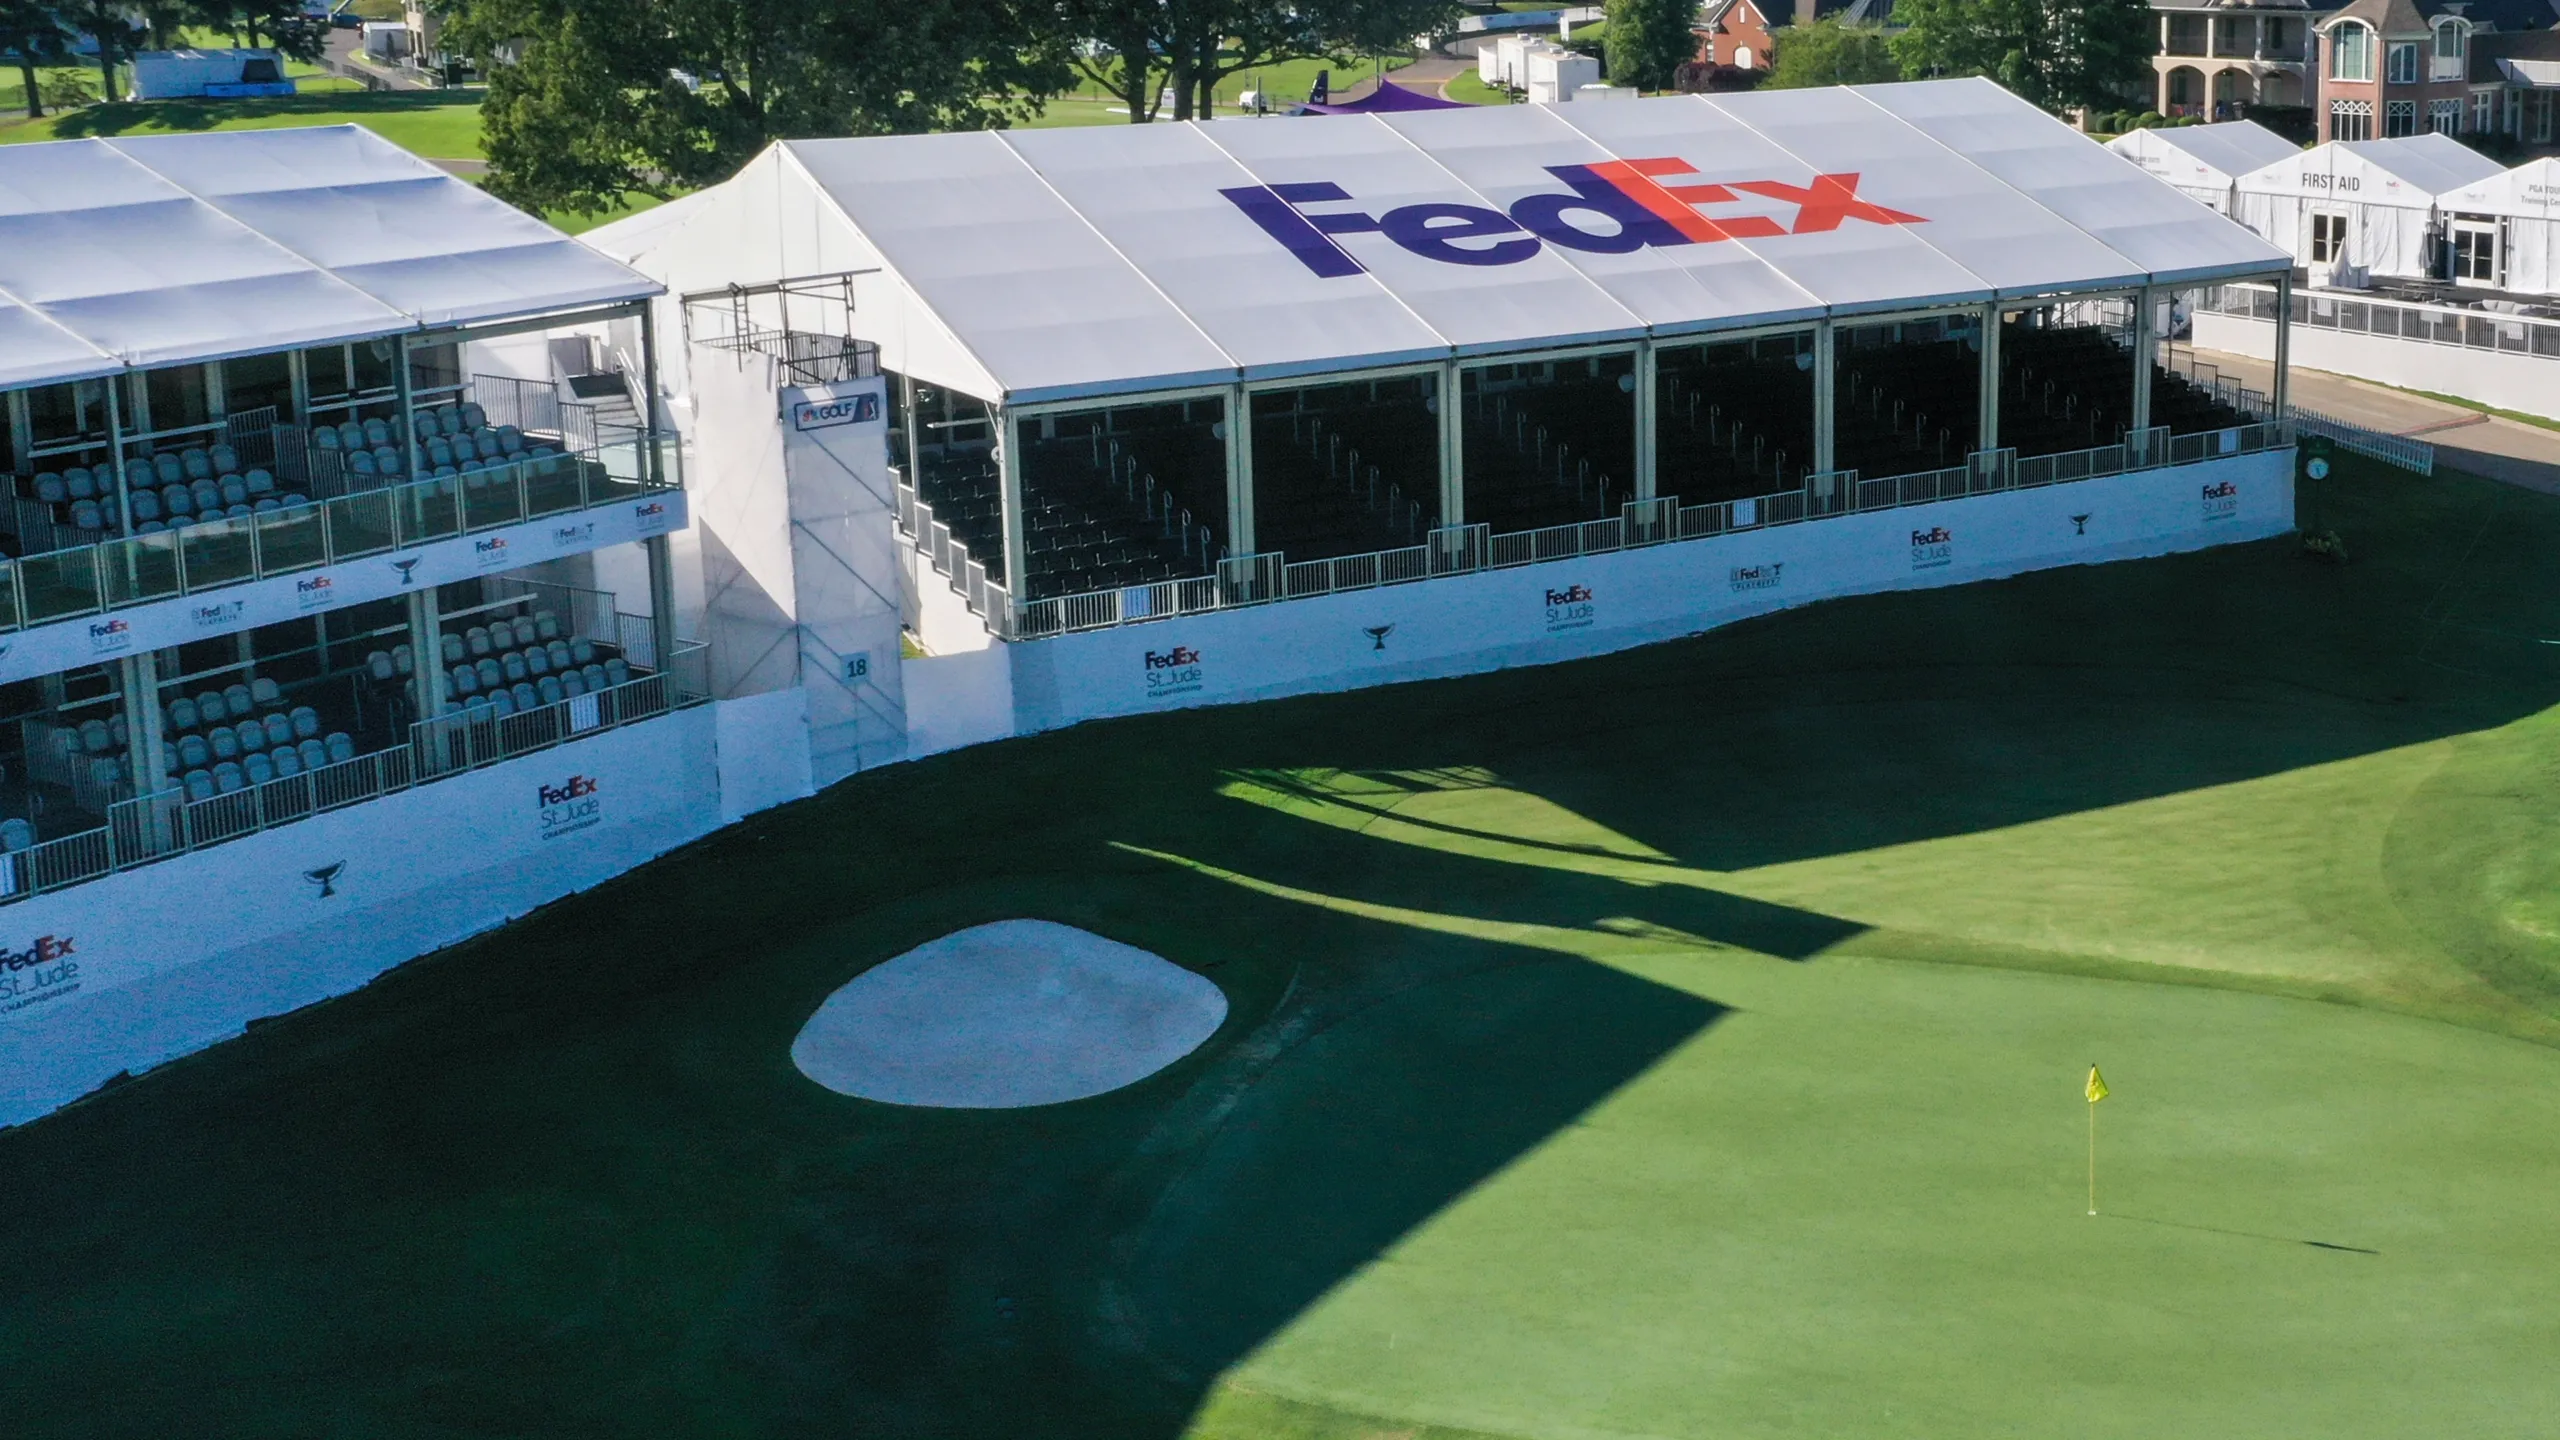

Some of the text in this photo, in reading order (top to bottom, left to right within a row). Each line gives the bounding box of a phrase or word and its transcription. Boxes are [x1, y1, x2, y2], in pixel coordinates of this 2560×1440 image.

[2302, 172, 2360, 191] FIRST AID
[2545, 185, 2560, 194] TOU
[1217, 156, 1933, 279] FedEx
[820, 403, 852, 419] GOLF
[2202, 481, 2237, 500] FedEx
[636, 503, 664, 517] FedEx
[476, 537, 507, 553] FedEx
[1912, 527, 1951, 546] FedEx
[297, 576, 332, 592] FedEx
[1545, 584, 1592, 606] FedEx
[1564, 603, 1594, 620] Jude
[90, 620, 129, 637] FedEx
[847, 658, 867, 678] 18
[1145, 647, 1200, 670] FedEx
[1166, 666, 1202, 686] Jude
[539, 774, 597, 809] FedEx
[563, 797, 599, 822] Jude
[0, 934, 76, 974] FedEx
[28, 960, 79, 991] Jude
